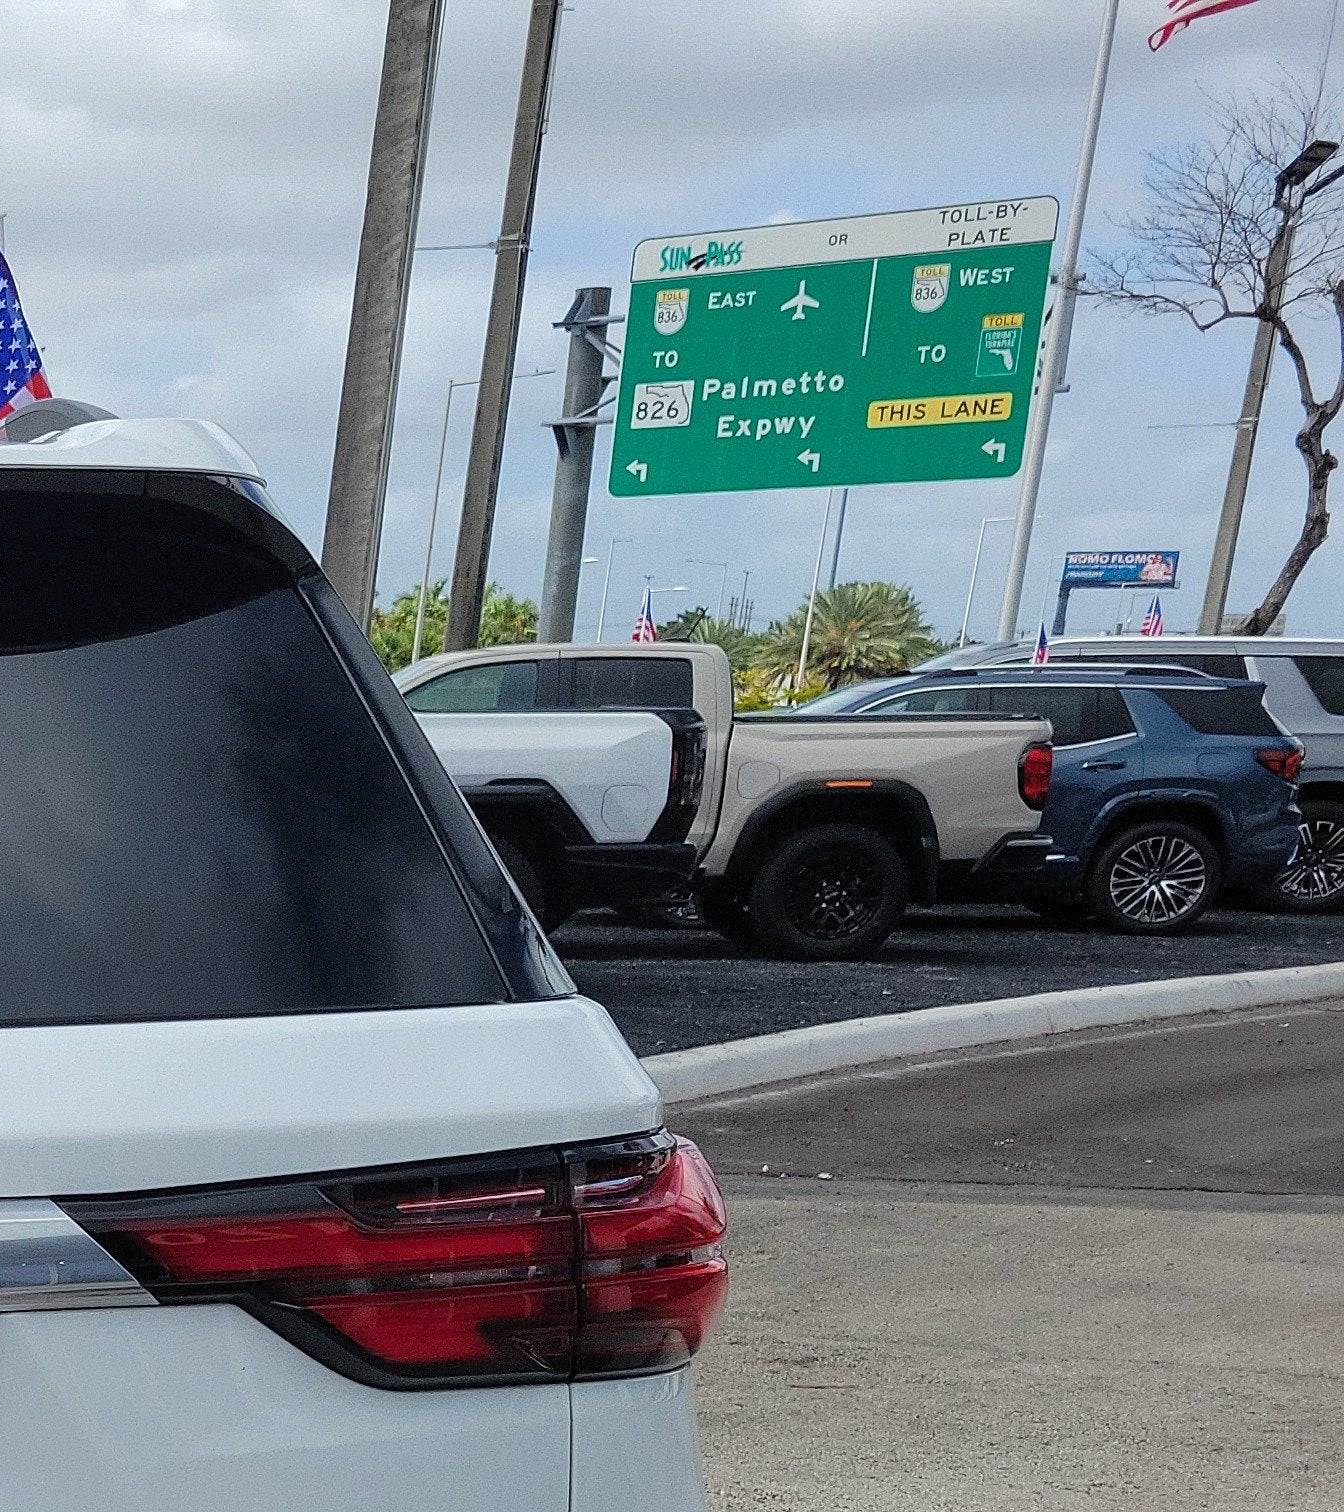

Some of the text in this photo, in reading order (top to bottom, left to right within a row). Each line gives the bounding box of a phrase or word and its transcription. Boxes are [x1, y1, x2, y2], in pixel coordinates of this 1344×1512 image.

[939, 202, 1029, 225] TOLL-BY-
[828, 232, 849, 247] OR
[947, 227, 1012, 247] PLATE
[920, 267, 945, 277] TOLL
[959, 266, 1015, 287] WEST
[662, 292, 685, 300] TOLL
[707, 290, 757, 310] EAST
[914, 287, 938, 301] 836
[657, 310, 678, 324] 836
[988, 316, 1018, 327] TOLL
[652, 350, 679, 369] TO
[917, 344, 947, 364] TO
[702, 370, 845, 401] Palmetto
[635, 399, 680, 421] 826
[876, 397, 1005, 422] THIS LANE
[716, 414, 816, 441] Expwy
